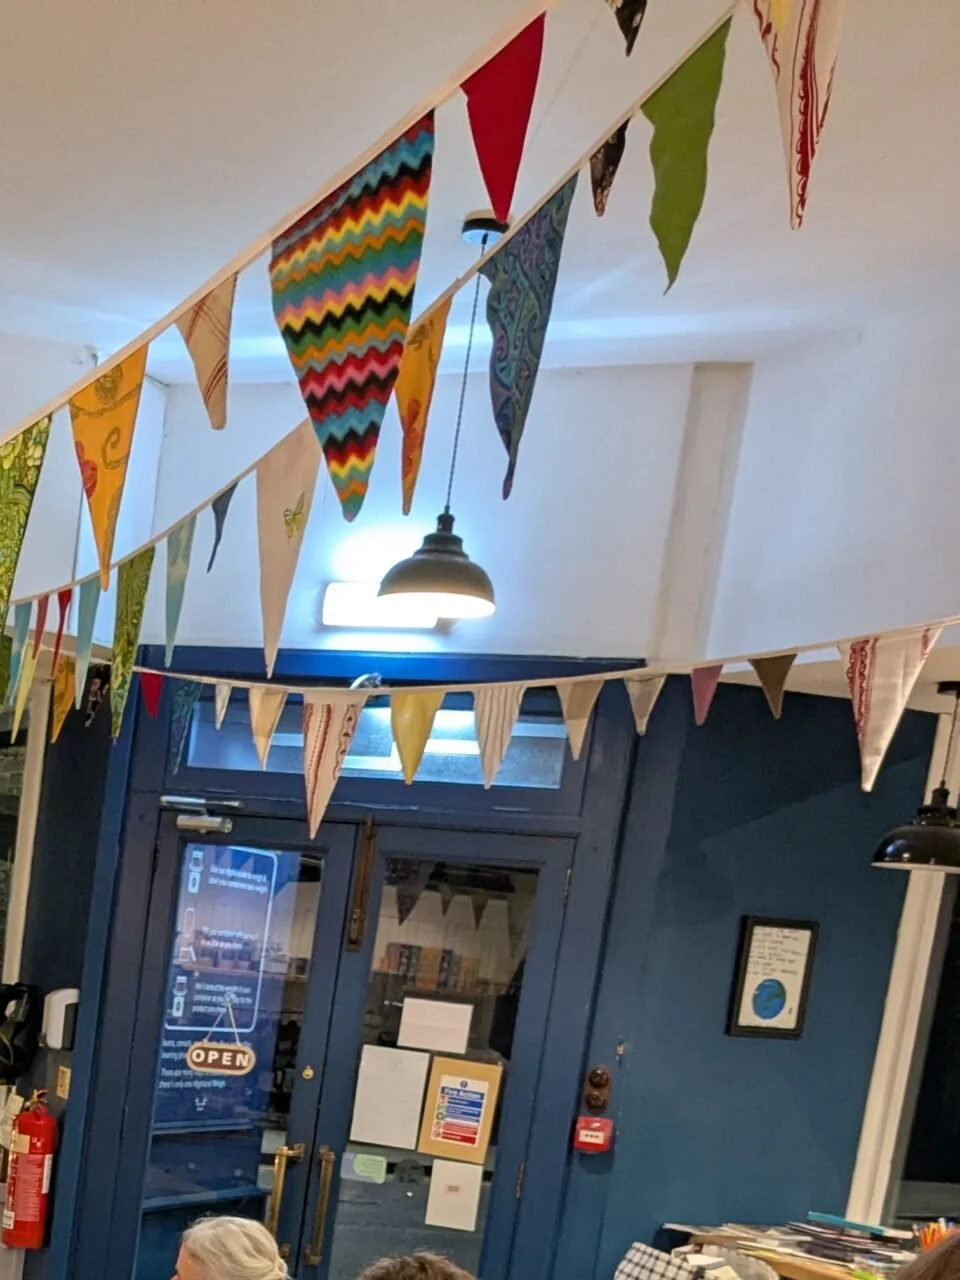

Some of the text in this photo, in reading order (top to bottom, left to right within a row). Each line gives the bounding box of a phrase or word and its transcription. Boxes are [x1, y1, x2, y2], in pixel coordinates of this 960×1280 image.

[191, 1049, 249, 1067] OPEN
[444, 1088, 482, 1100] Fire Action
